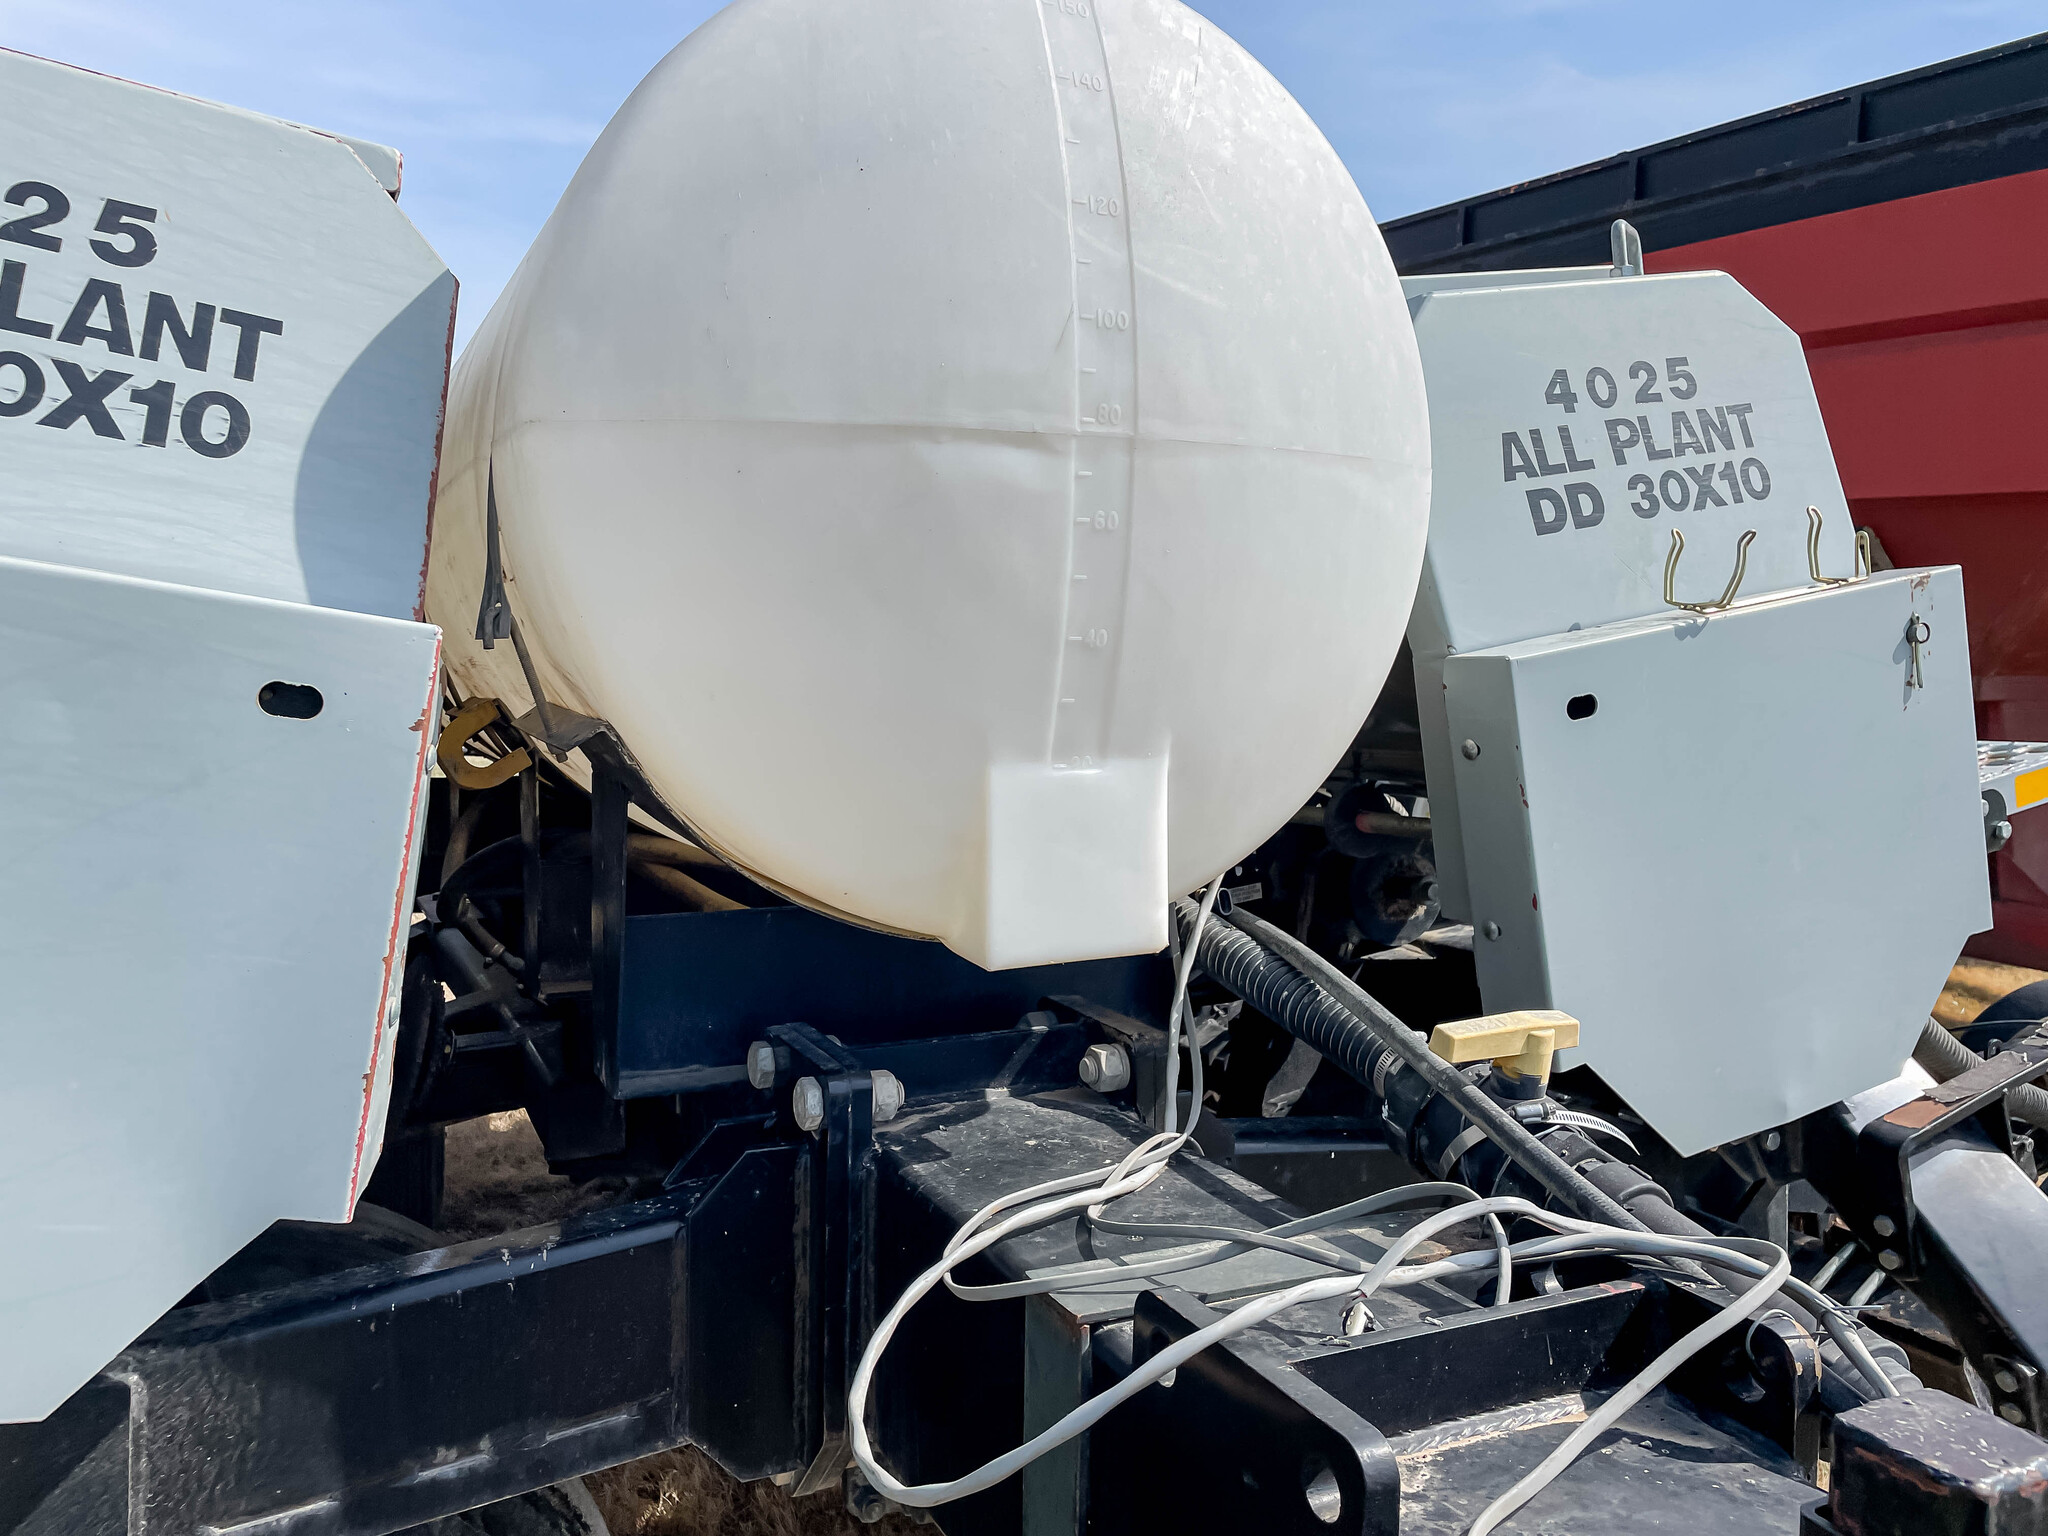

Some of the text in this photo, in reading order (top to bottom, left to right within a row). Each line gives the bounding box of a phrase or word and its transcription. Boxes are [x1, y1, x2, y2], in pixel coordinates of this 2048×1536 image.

[1072, 71, 1104, 92] 140
[1088, 194, 1118, 218] 120
[0, 259, 283, 382] LANT
[1096, 308, 1129, 331] 100
[1544, 356, 1698, 413] 4025
[1096, 403, 1122, 426] 80
[1501, 403, 1755, 482] ALL PLANT
[1525, 457, 1771, 536] DD 30X10
[1094, 510, 1119, 530] 60
[1084, 628, 1109, 649] 40
